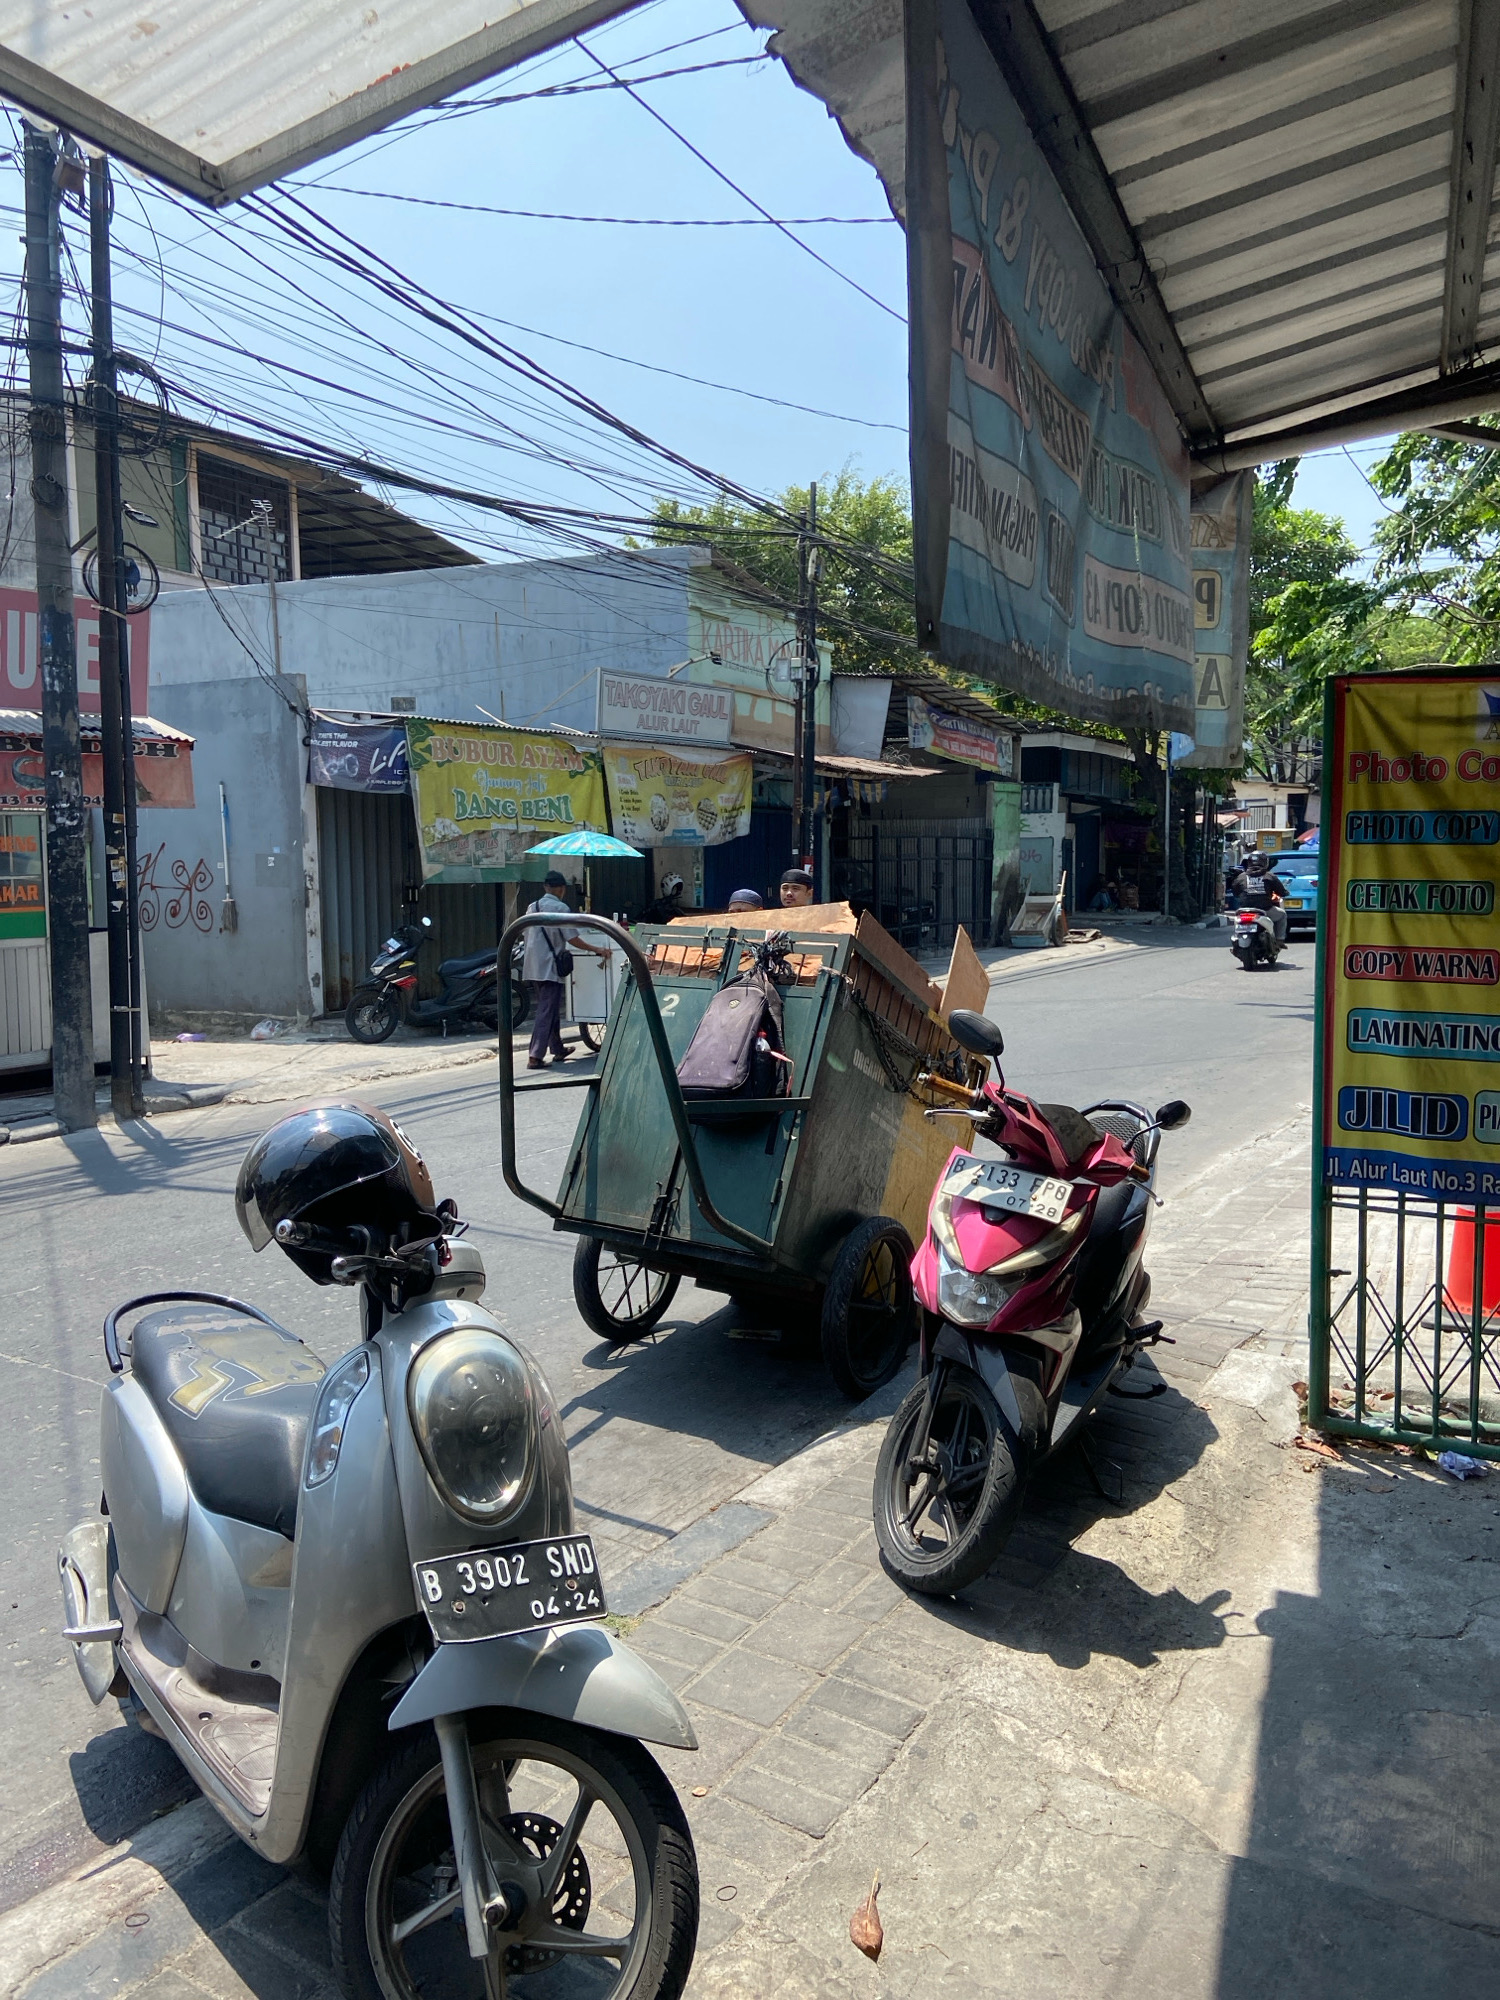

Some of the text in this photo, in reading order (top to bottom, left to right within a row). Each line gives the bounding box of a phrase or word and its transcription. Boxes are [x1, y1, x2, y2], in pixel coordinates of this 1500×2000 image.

[605, 680, 729, 720] TAKOYAKI GAUL
[637, 713, 700, 734] ALUR LAUT
[429, 736, 585, 772] BUBUR AYAM
[1348, 751, 1449, 783] Photo
[452, 787, 575, 823] BANG BENI
[1348, 813, 1495, 841] PHOTO COPY
[1350, 882, 1489, 912] CETAK FOTO
[1347, 950, 1496, 980] COPY WARNA
[661, 994, 680, 1018] 2
[1345, 1088, 1461, 1138] JILID
[953, 1157, 966, 1174] B
[1327, 1157, 1345, 1178] Jl.
[1350, 1158, 1388, 1181] Alur
[1392, 1162, 1429, 1188] Laut
[421, 1542, 594, 1603] B 3902 SND
